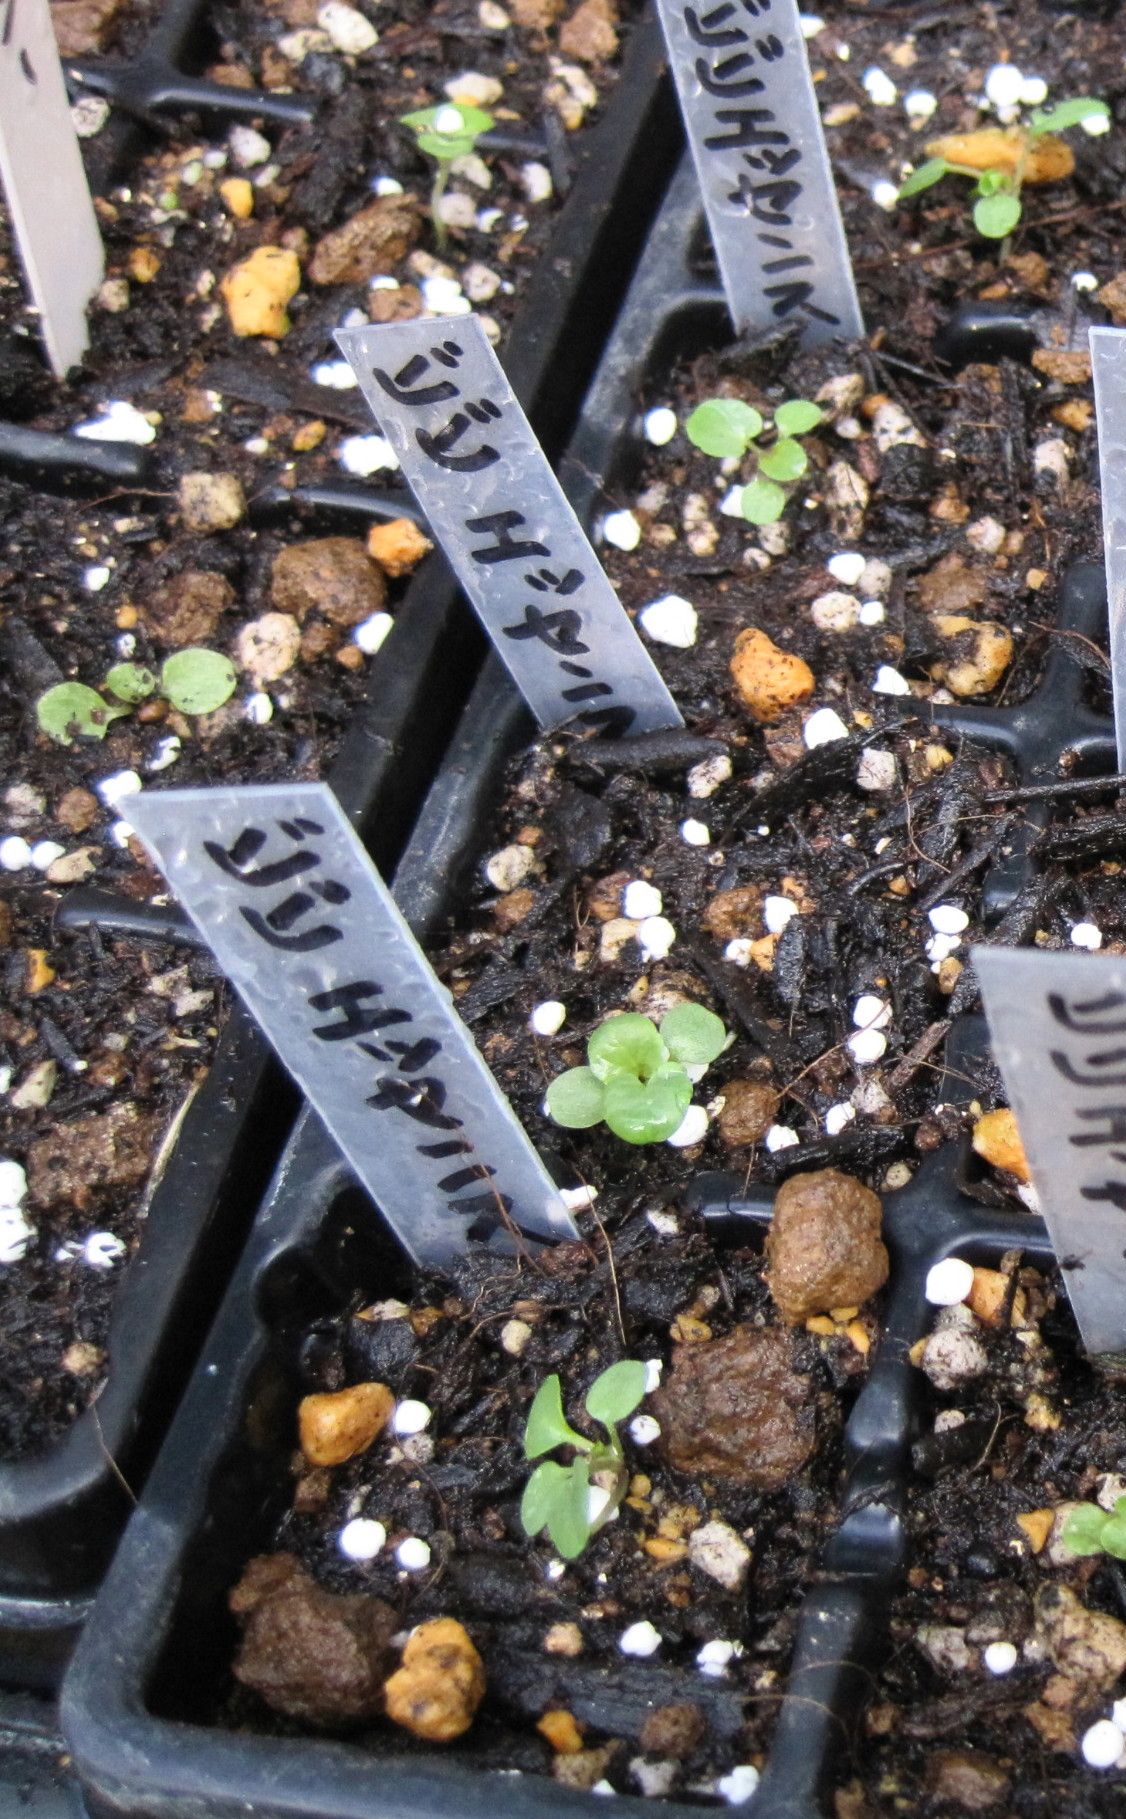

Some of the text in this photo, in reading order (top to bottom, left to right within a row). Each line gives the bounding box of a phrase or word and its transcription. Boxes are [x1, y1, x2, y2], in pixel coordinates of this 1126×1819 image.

[203, 816, 562, 1246] ビビエッセンス
